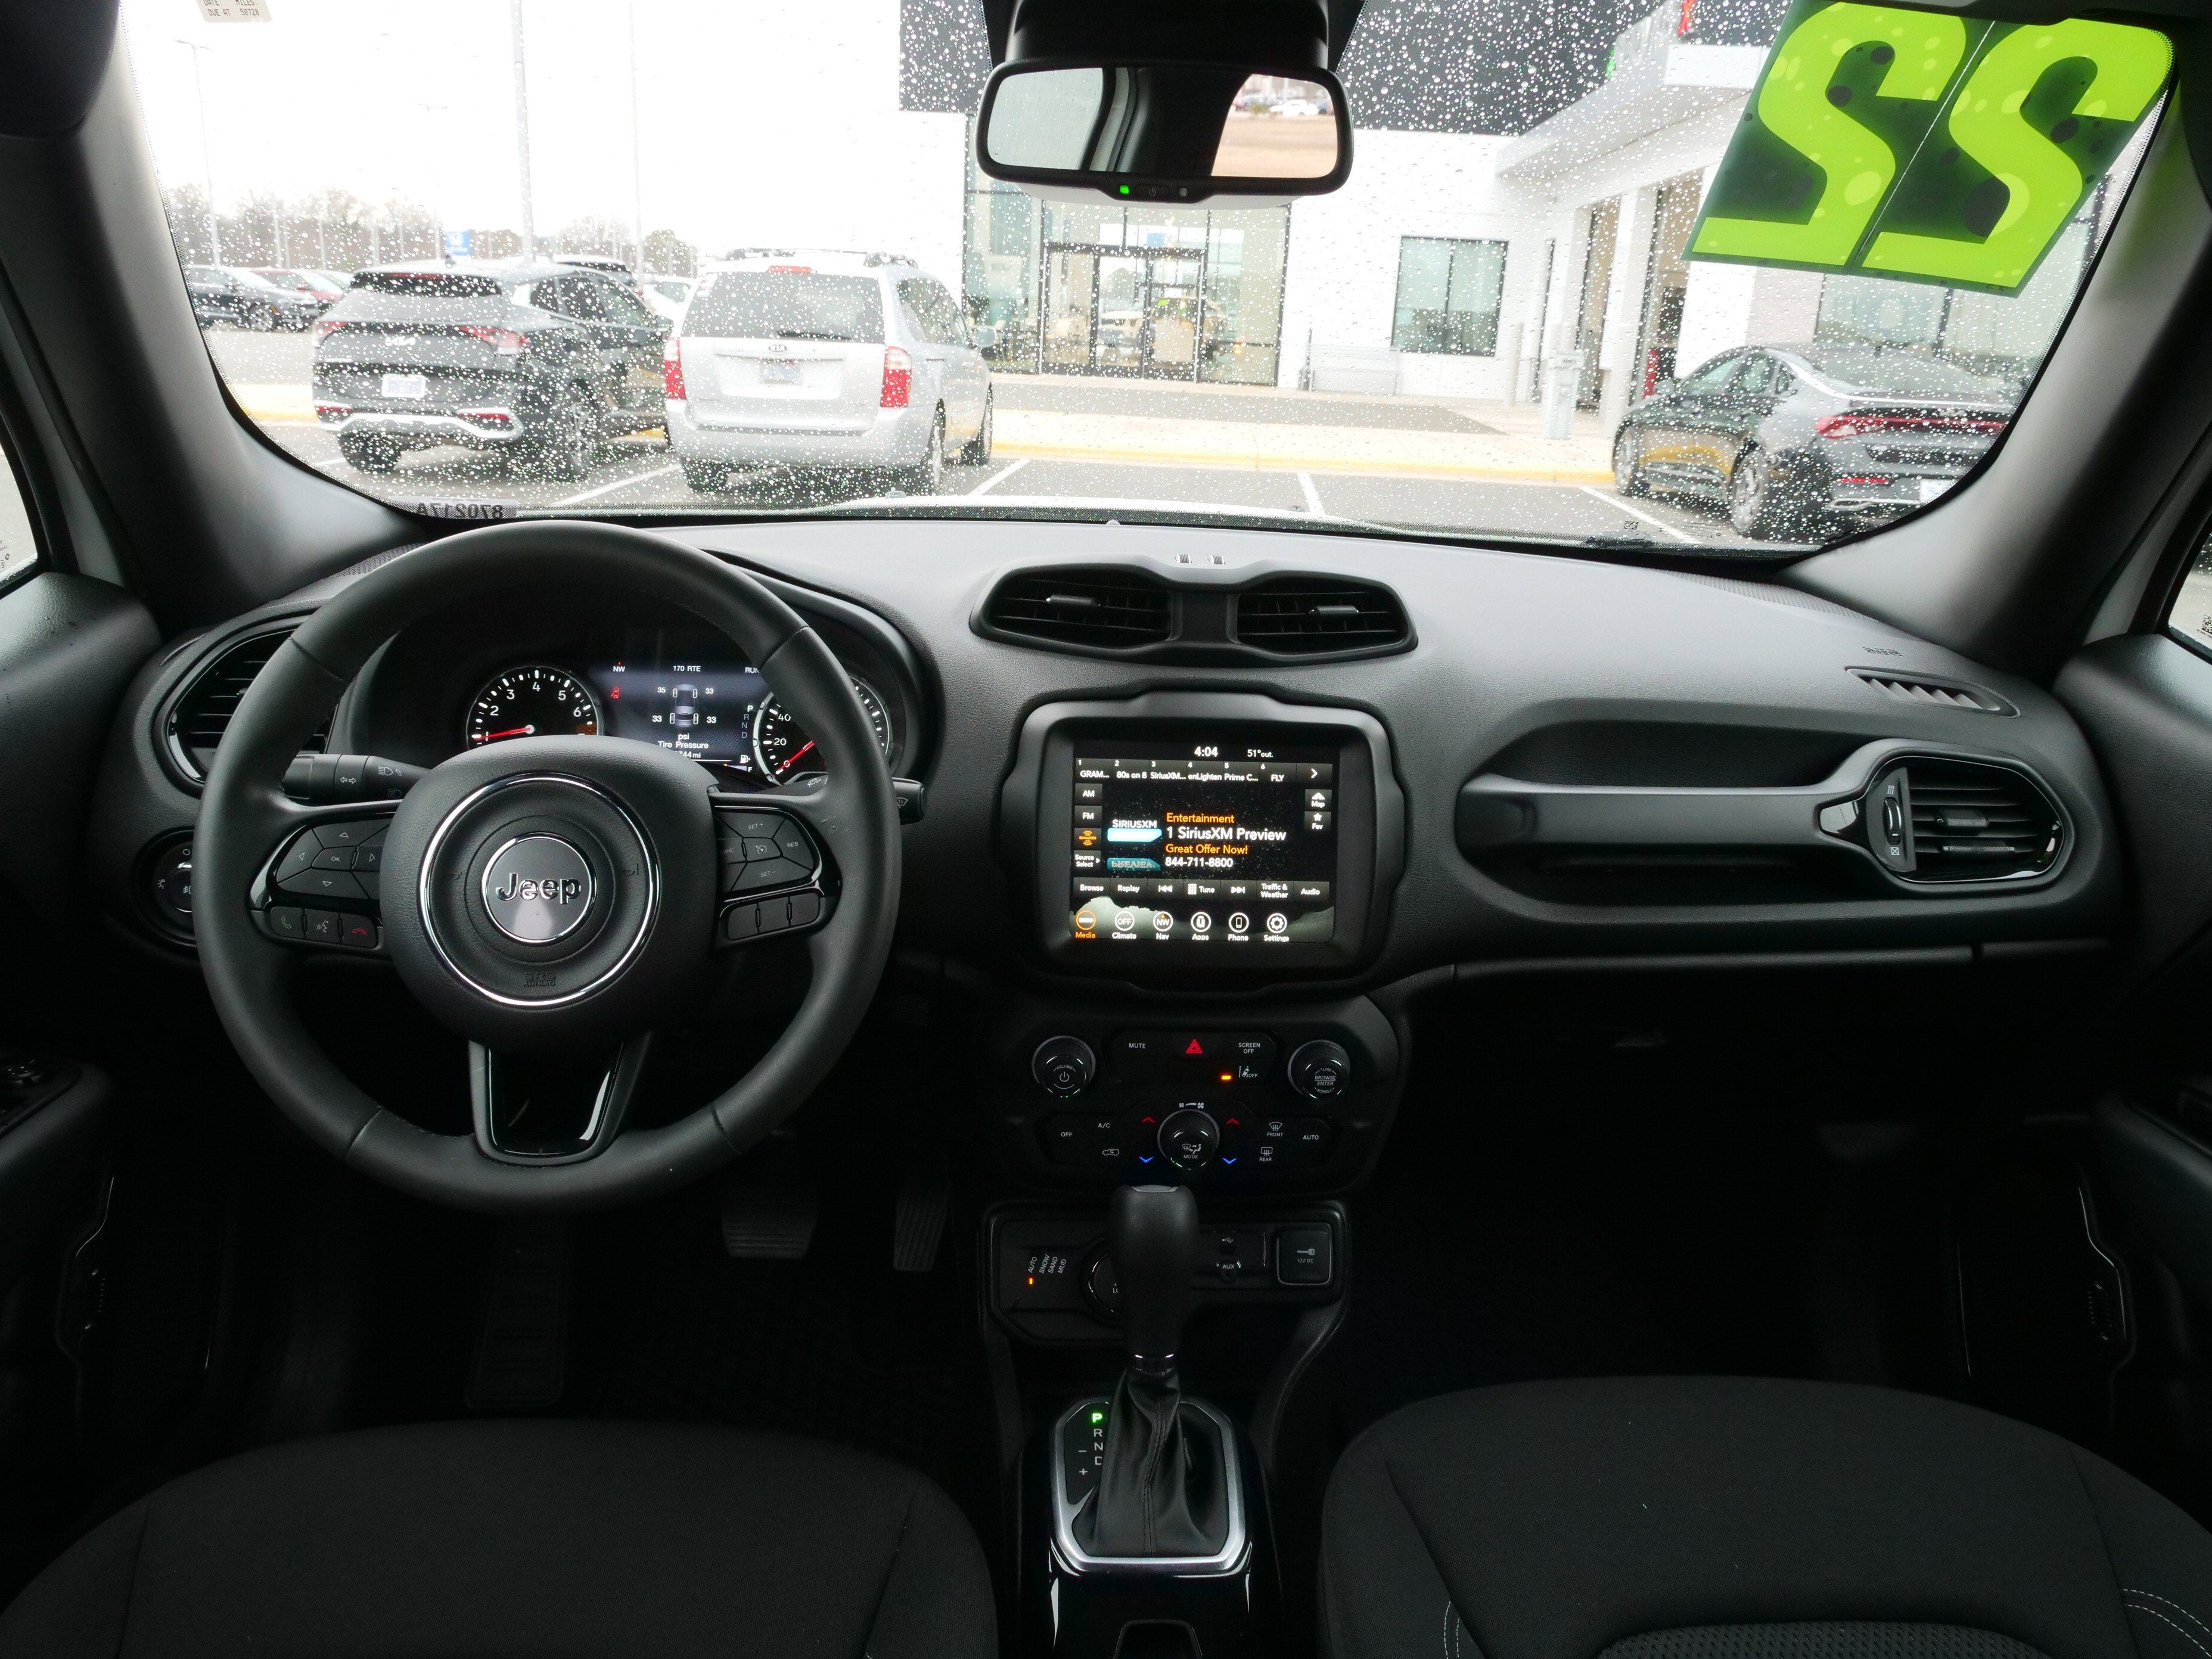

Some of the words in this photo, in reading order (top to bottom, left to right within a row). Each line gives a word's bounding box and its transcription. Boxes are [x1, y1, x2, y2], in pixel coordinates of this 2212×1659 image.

[532, 682, 540, 692] 4
[507, 689, 515, 700] 3
[558, 690, 566, 701] 5
[490, 705, 499, 716] 2
[573, 707, 582, 717] 6
[1194, 746, 1218, 757] 4:04
[1188, 773, 1222, 781] enLighten
[1112, 819, 1157, 828] SIRIUSXM
[1167, 812, 1235, 824] Entertainment
[1167, 827, 1172, 838] 1
[1178, 827, 1233, 840] SiriusXM
[1237, 828, 1287, 841] Preview
[1166, 843, 1193, 853] Great
[1195, 844, 1220, 853] Offer
[1223, 845, 1248, 855] Now!
[1165, 856, 1234, 868] 844-711-8800
[496, 873, 581, 905] Jeep
[1117, 884, 1140, 893] Replay
[1263, 934, 1290, 943] Settings
[1027, 1256, 1037, 1273] AUTO
[1039, 1254, 1050, 1274] SNOW
[1048, 1256, 1058, 1273] SAND
[1057, 1259, 1067, 1274] MUD
[1092, 1412, 1102, 1423] P
[1093, 1428, 1102, 1437] R
[1094, 1442, 1103, 1451] N
